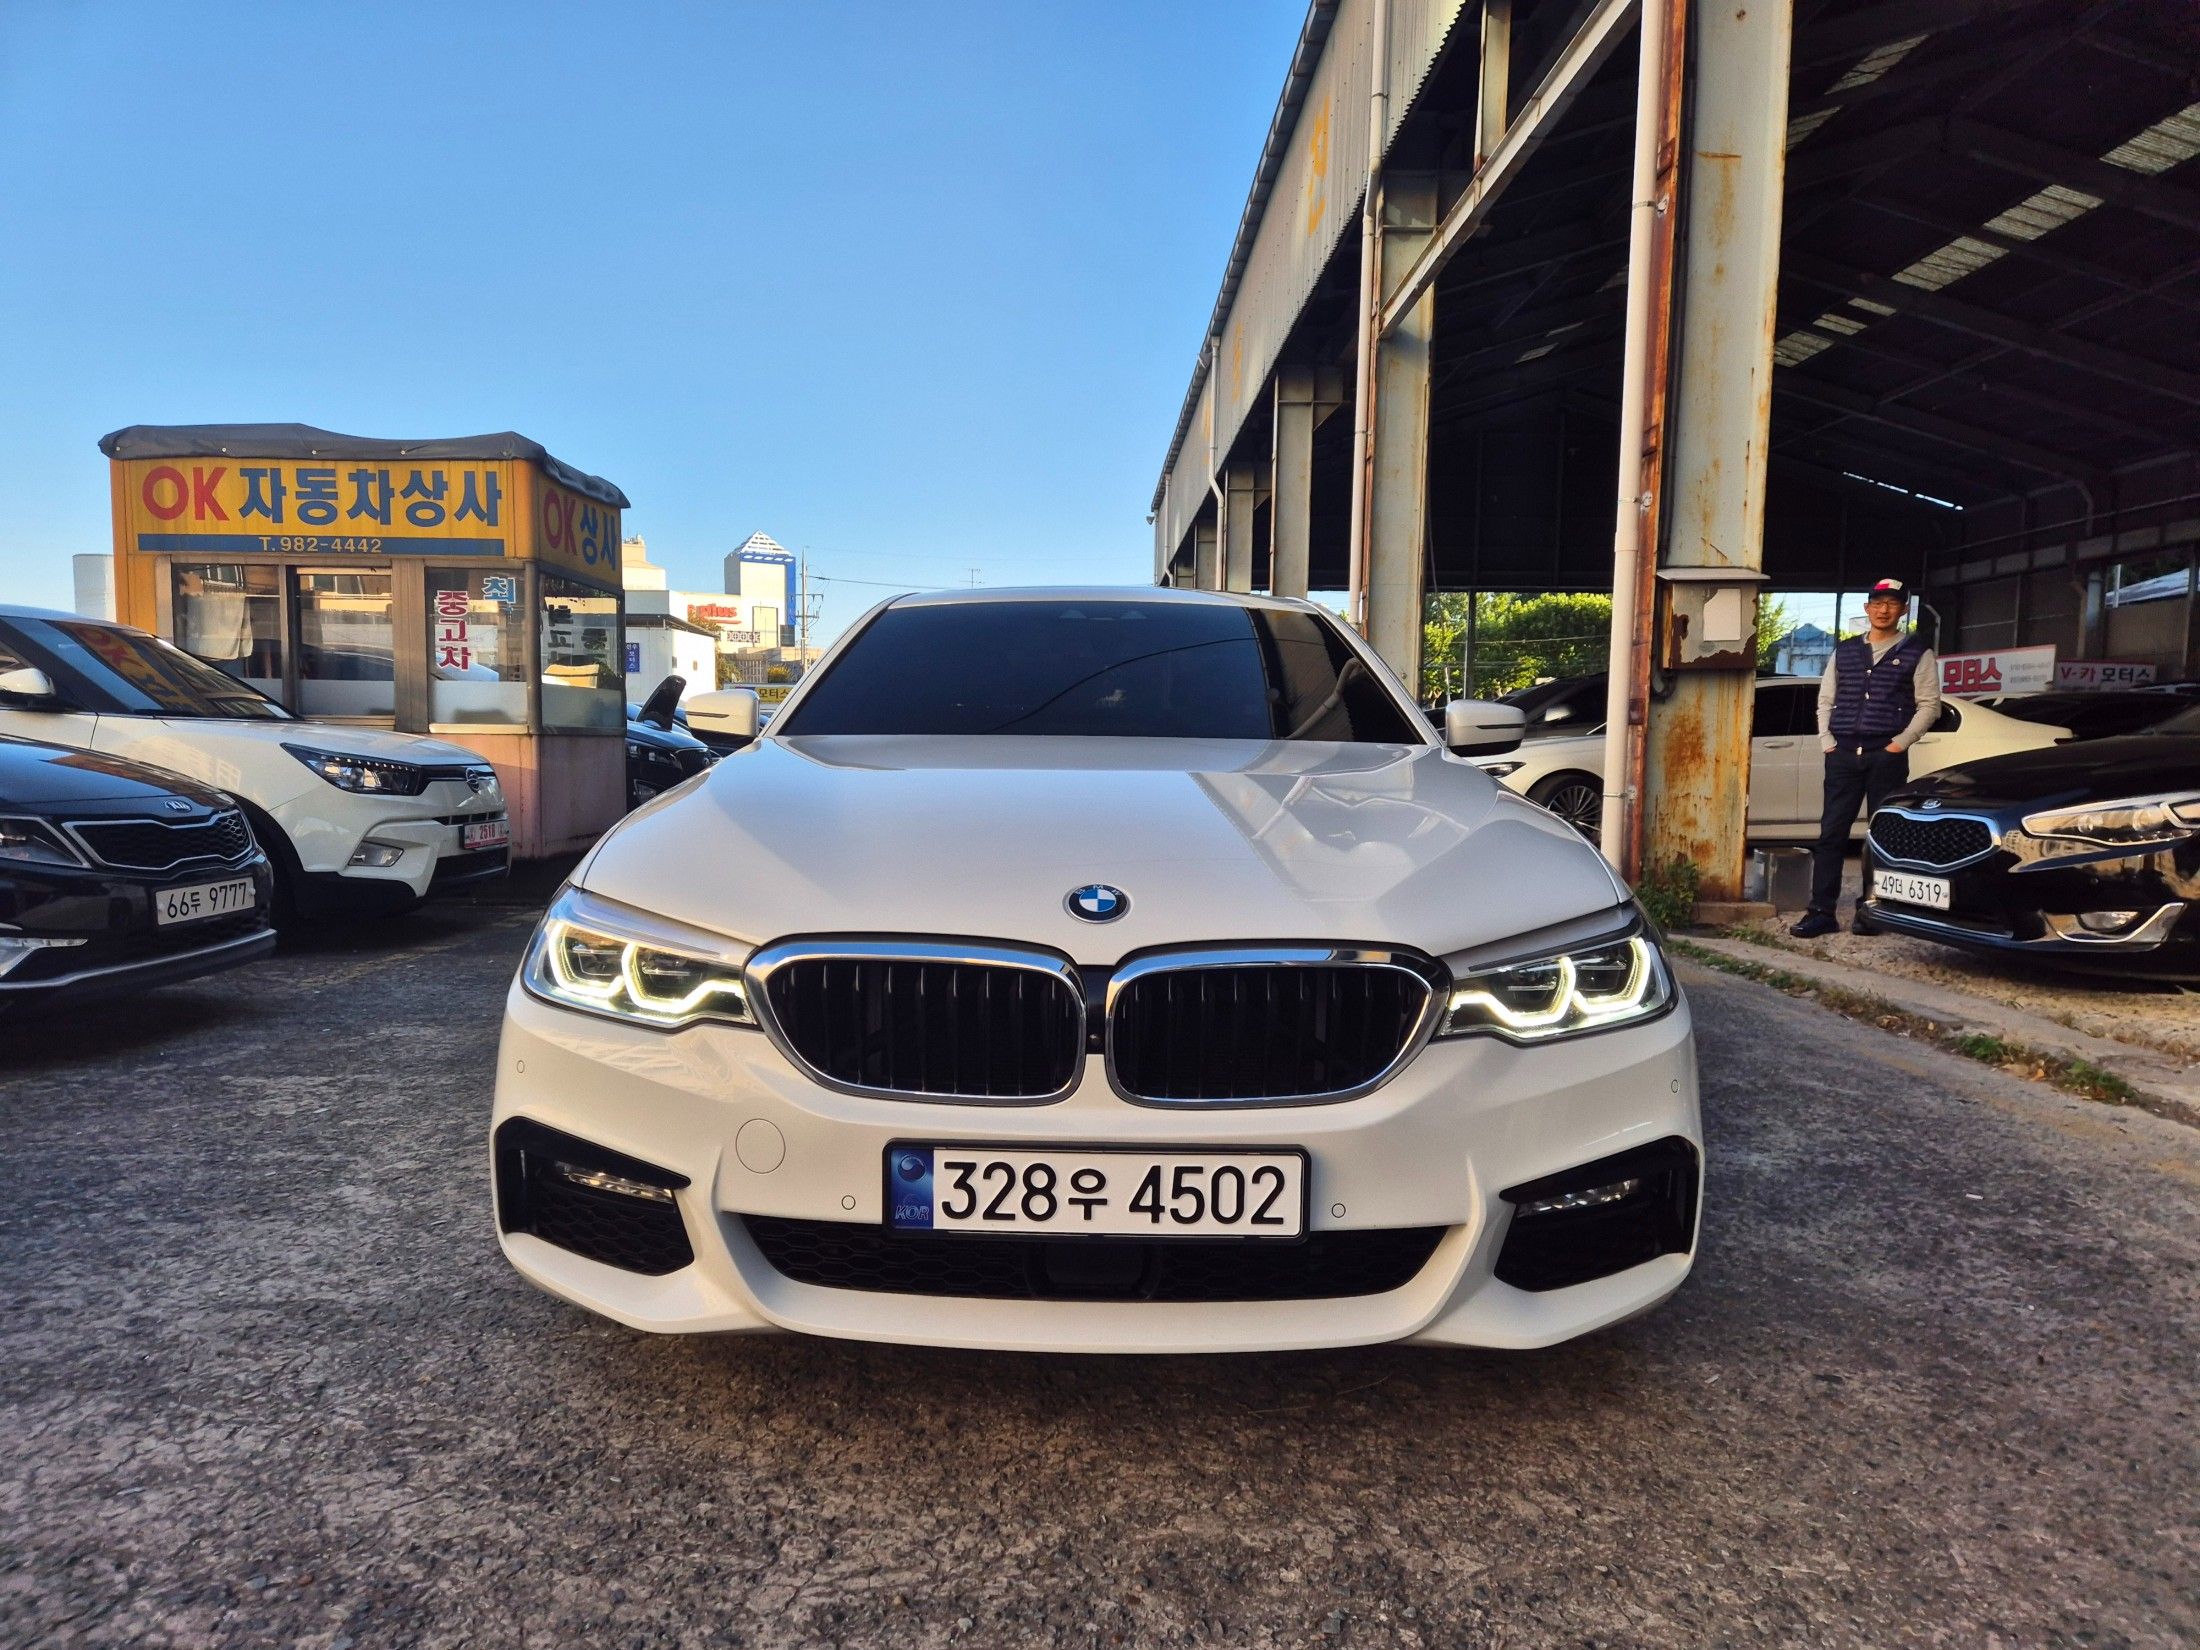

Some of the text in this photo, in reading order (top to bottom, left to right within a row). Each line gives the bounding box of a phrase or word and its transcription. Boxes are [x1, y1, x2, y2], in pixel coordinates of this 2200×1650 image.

[437, 591, 471, 669] 중고차
[1941, 657, 2002, 693] 모터스
[2101, 666, 2151, 682] 모터스
[758, 687, 789, 699] 모터스
[167, 882, 247, 918] 66두 9777
[1908, 879, 1942, 903] 6319
[941, 1161, 1286, 1225] 328우 4502
[895, 1205, 930, 1220] KOR
